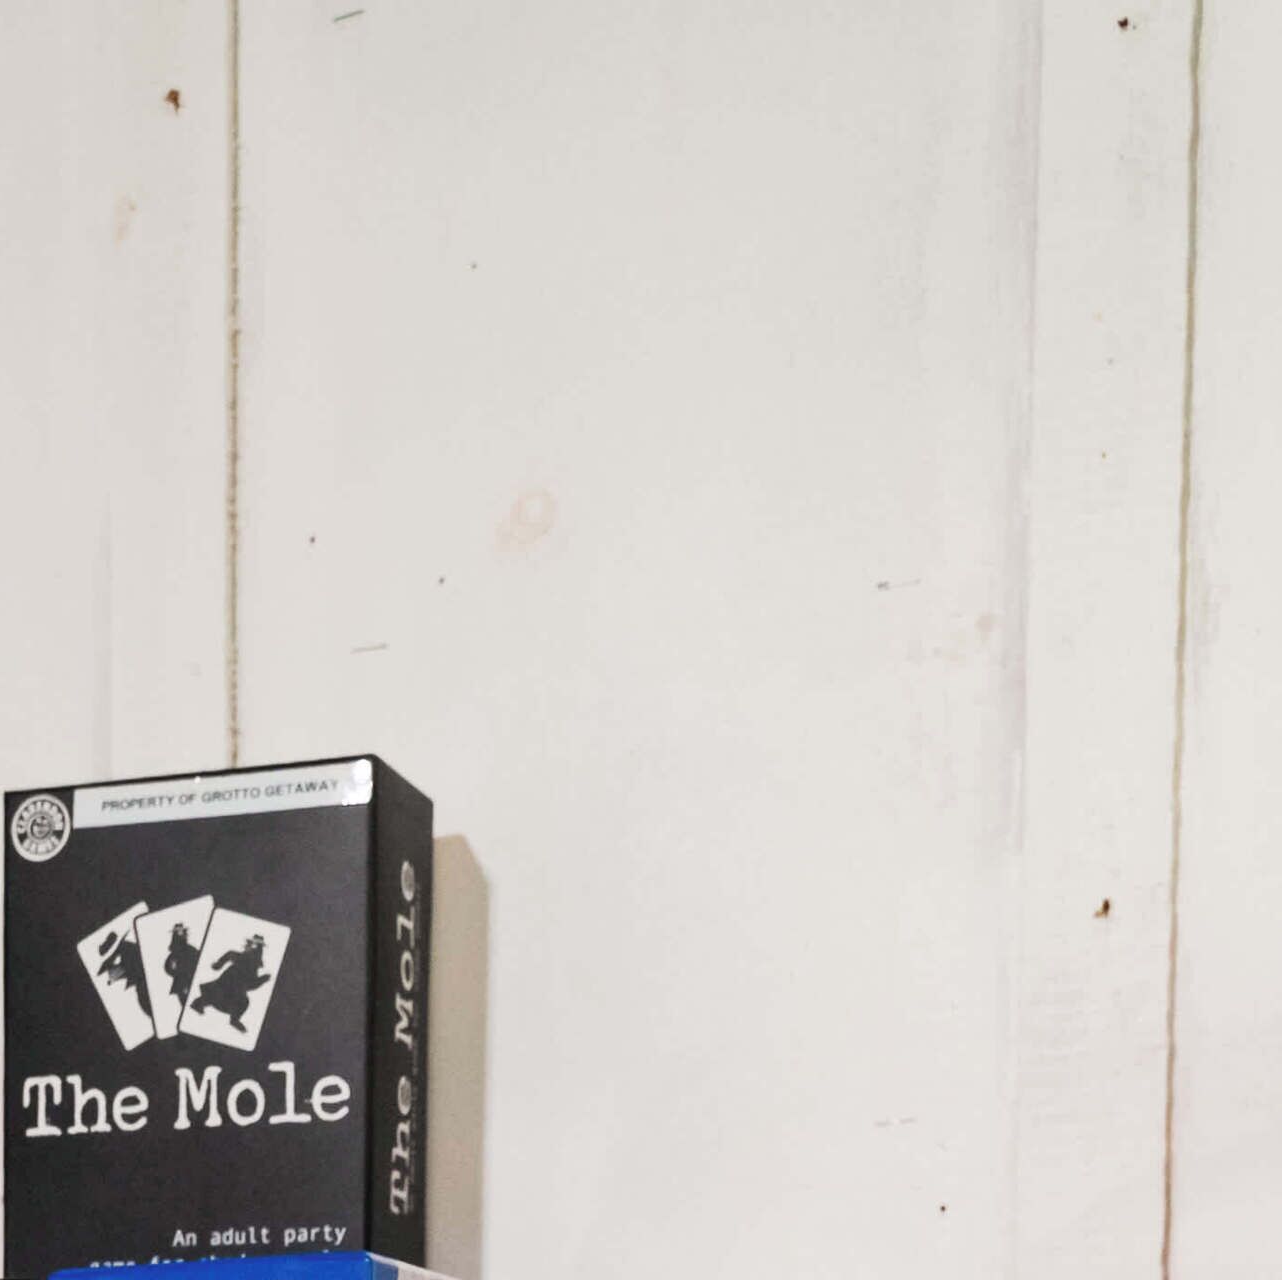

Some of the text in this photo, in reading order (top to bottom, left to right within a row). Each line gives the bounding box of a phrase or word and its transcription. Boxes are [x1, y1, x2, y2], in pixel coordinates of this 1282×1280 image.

[101, 779, 339, 813] PROPERTY OF GROTTO GETAWAY
[389, 859, 417, 1215] The Mole
[21, 1060, 352, 1138] The Mole
[172, 1224, 347, 1248] An adult party
